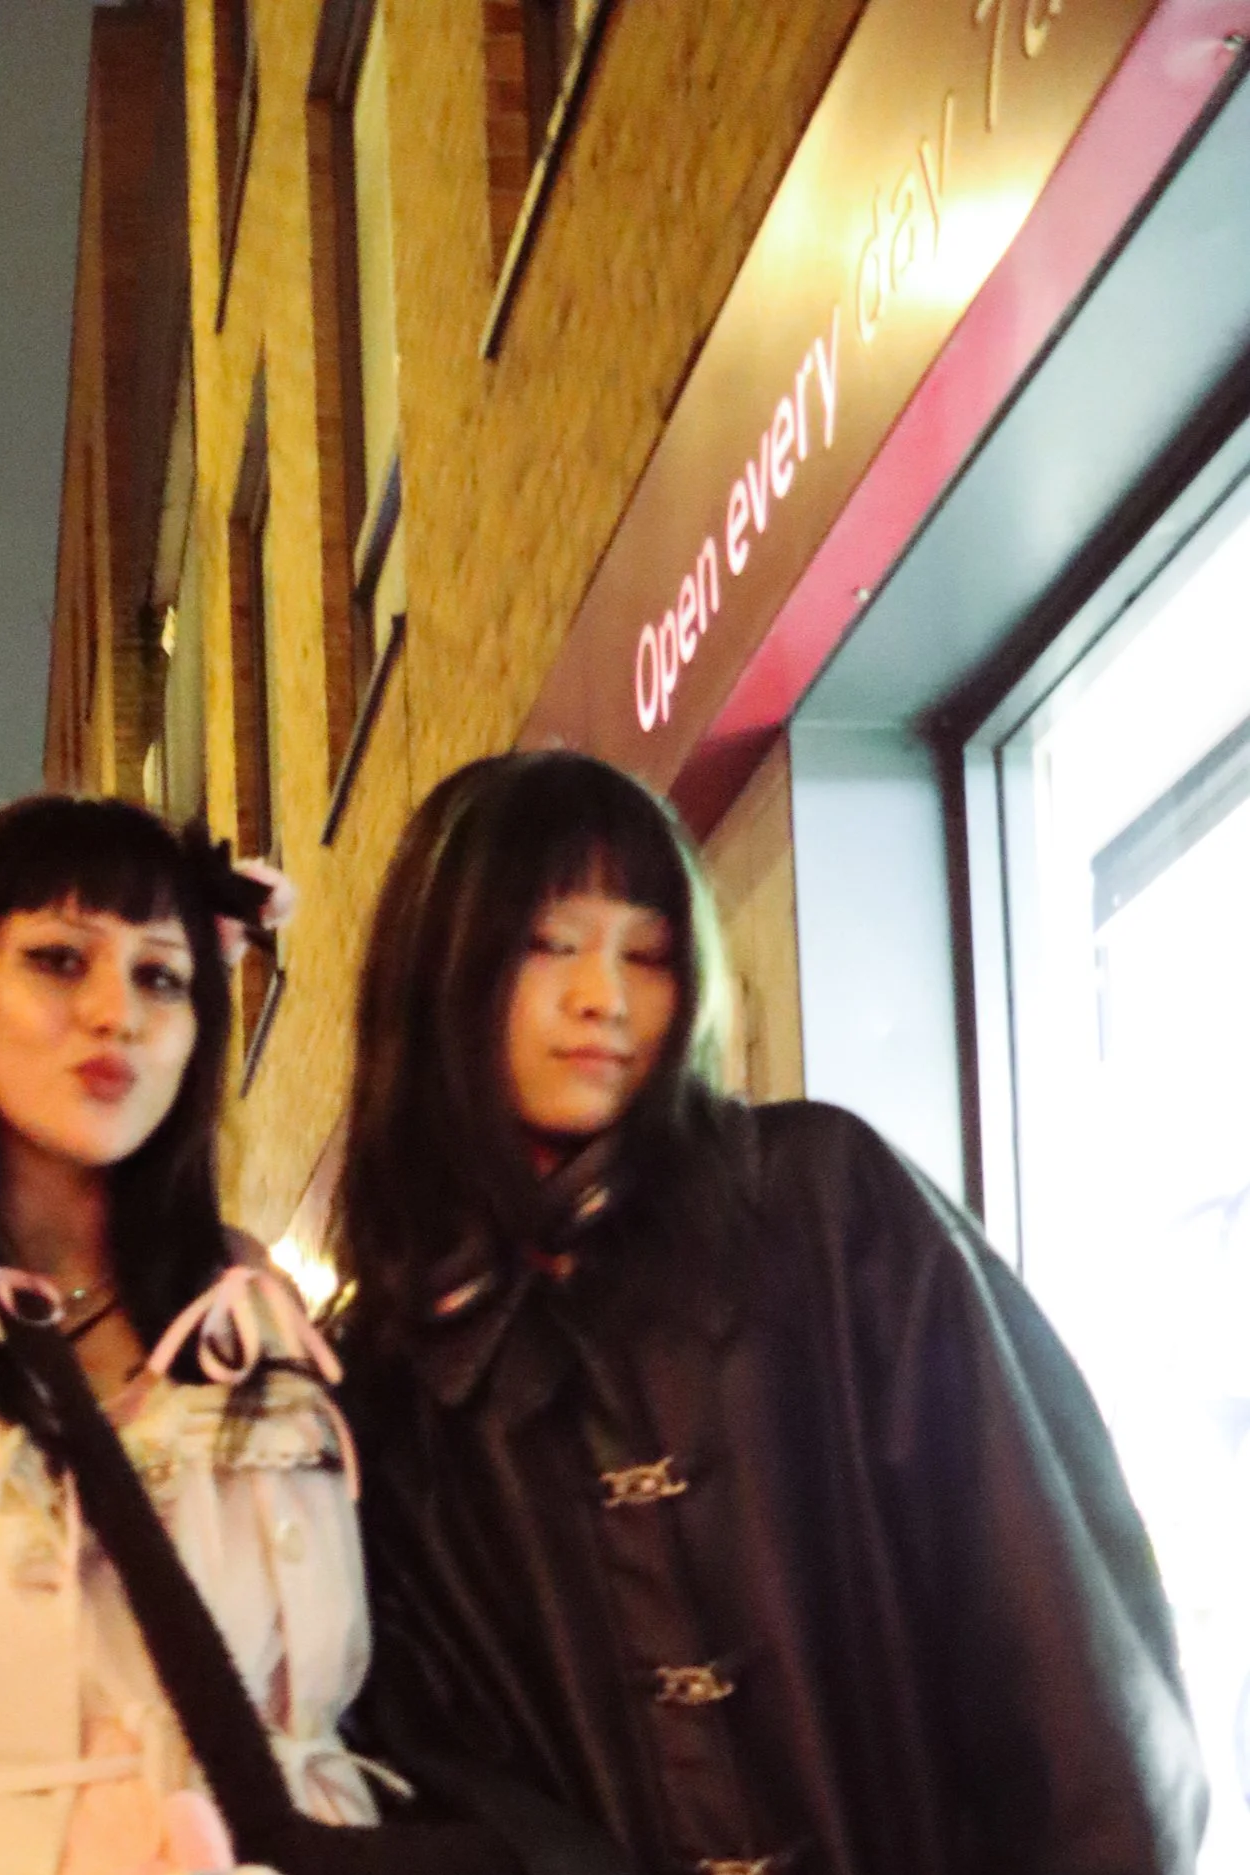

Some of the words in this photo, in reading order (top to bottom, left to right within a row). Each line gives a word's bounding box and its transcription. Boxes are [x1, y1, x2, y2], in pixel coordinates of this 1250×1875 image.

[634, 536, 721, 733] Open
[726, 304, 842, 577] every
[855, 92, 954, 346] day
